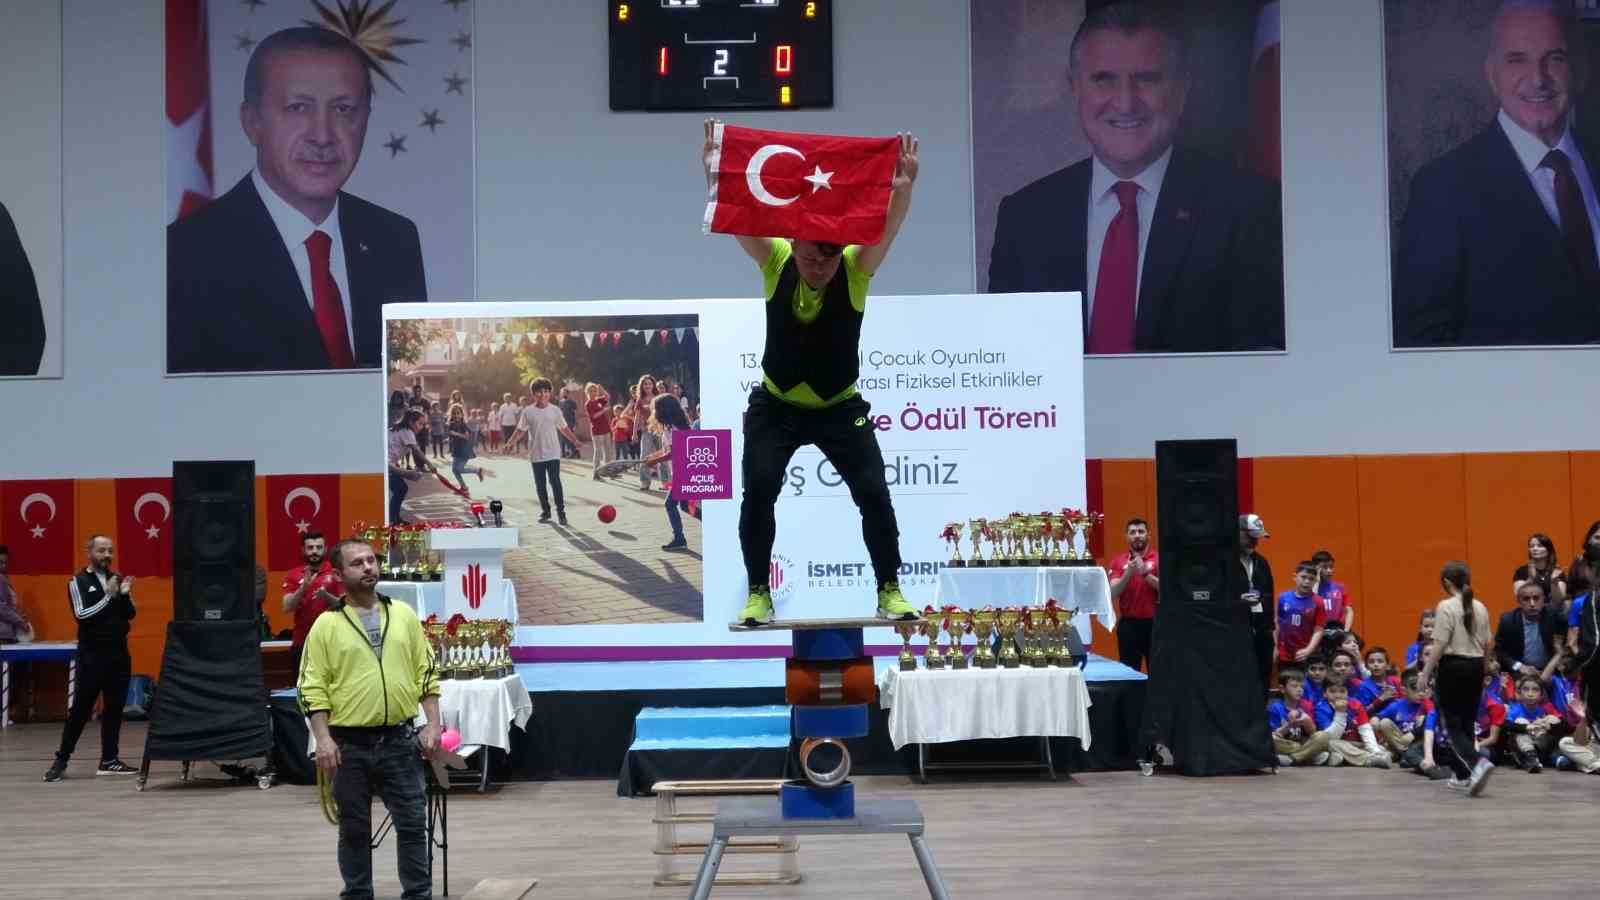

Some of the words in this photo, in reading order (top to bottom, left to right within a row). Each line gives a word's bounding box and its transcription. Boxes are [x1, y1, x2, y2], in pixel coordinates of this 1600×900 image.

[619, 5, 628, 19] 2
[806, 2, 815, 16] 2
[713, 49, 728, 75] 2
[776, 45, 791, 72] 0
[868, 350, 926, 371] Çocuk
[931, 348, 1006, 369] Oyunları
[896, 371, 956, 389] Fiziksel
[961, 371, 1043, 389] Etkinlikler
[900, 402, 966, 431] Ödül
[973, 404, 1057, 430] Töreni
[816, 455, 959, 487] Gdiniz
[681, 484, 724, 494] PROGRAMI
[1291, 613, 1302, 626] 10
